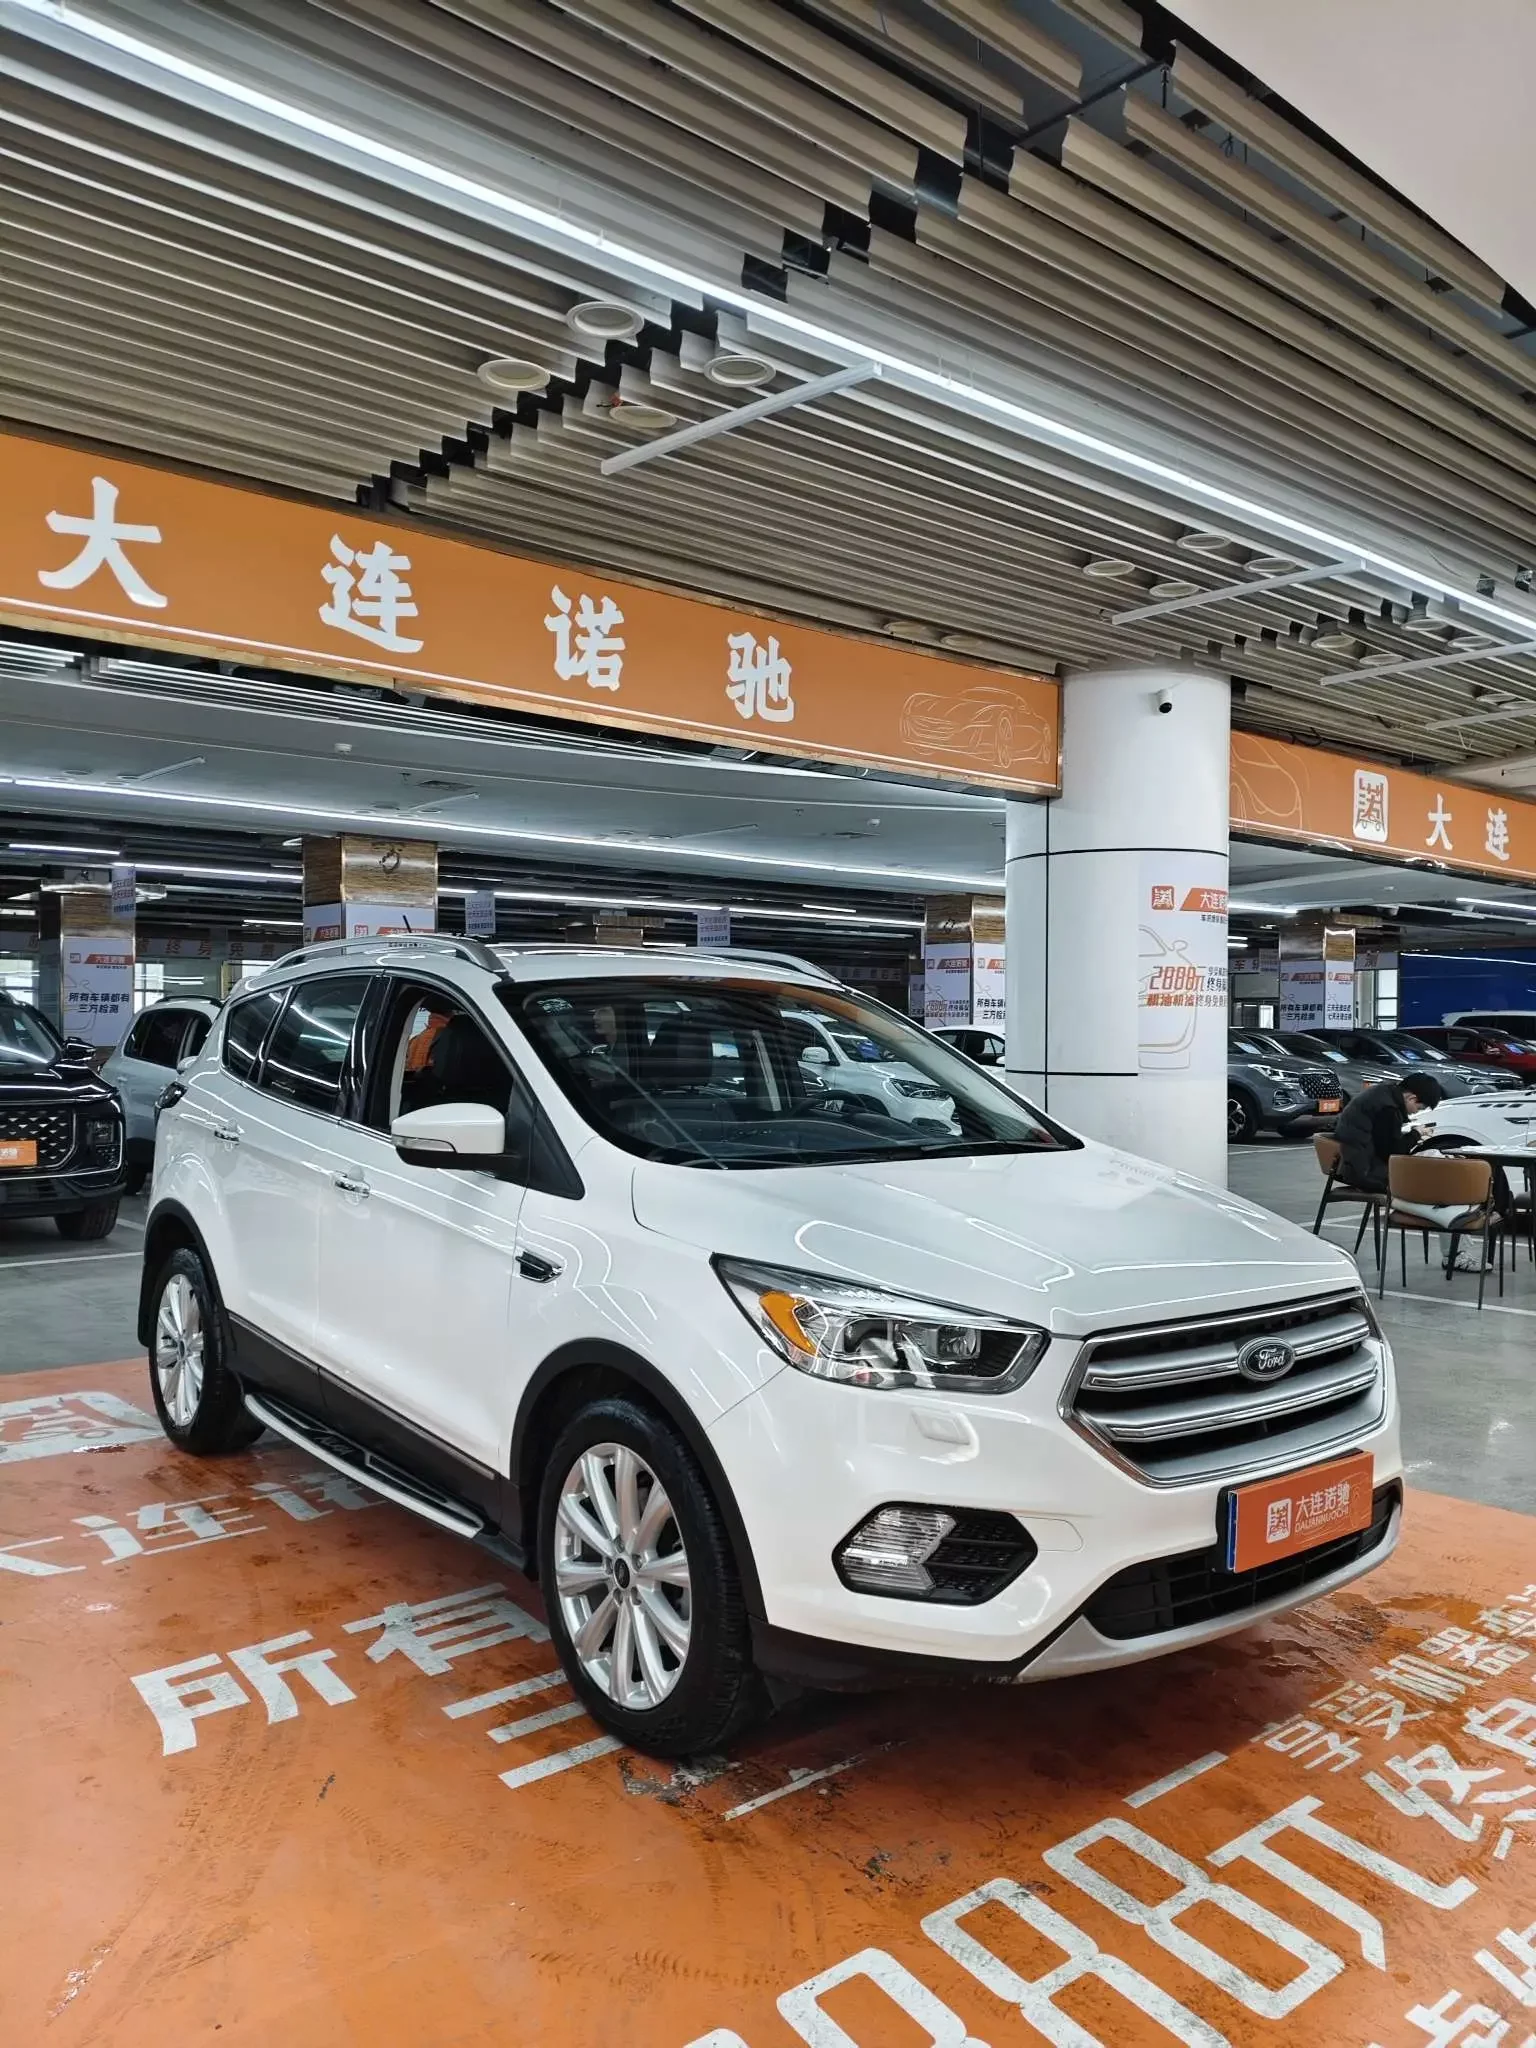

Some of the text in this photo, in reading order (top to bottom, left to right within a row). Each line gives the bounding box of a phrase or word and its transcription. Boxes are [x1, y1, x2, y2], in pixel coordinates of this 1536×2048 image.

[38, 476, 795, 723] 大连诺驰
[1425, 793, 1511, 861] 大连
[1256, 1348, 1286, 1370] Ford
[1295, 1483, 1350, 1519] 大连诺驰
